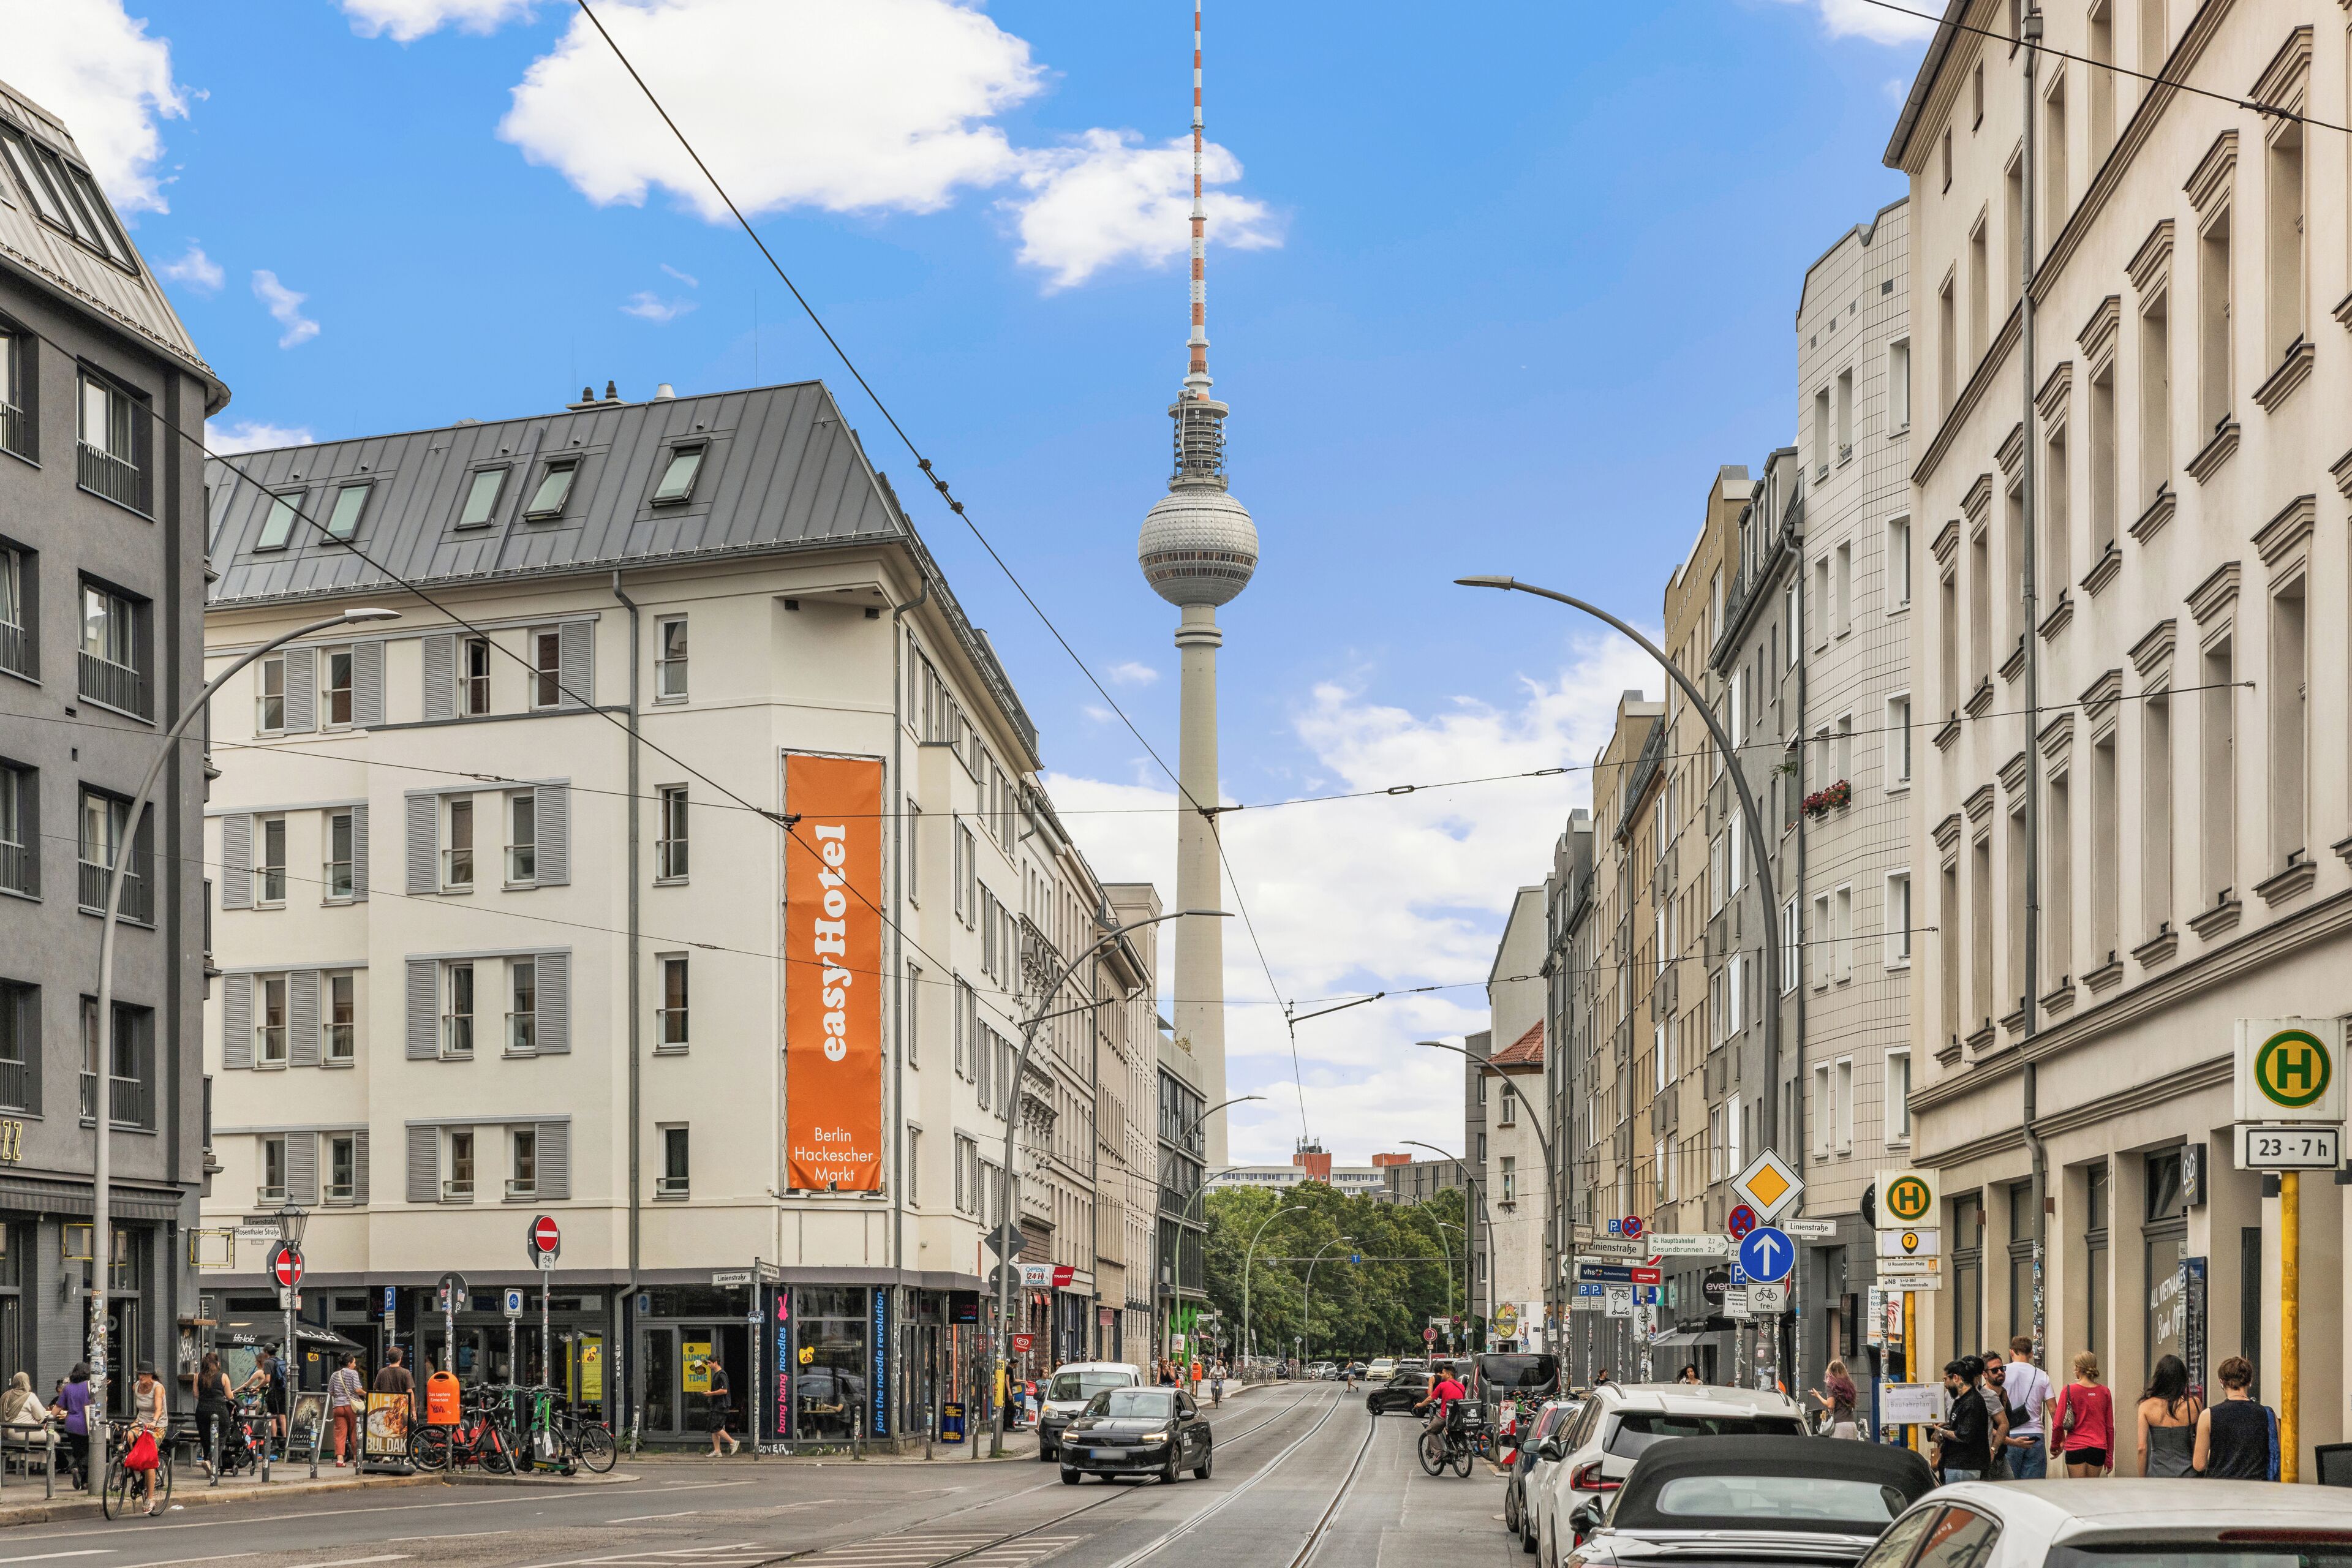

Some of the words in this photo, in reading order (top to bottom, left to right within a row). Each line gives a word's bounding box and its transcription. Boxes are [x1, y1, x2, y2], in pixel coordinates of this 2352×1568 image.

[815, 824, 852, 1061] easyHotel
[2277, 1049, 2312, 1089] H
[815, 1127, 851, 1142] Berlin
[795, 1146, 873, 1162] Hackescher
[2259, 1139, 2282, 1156] 23
[2301, 1139, 2312, 1156] 7
[2318, 1139, 2327, 1156] h
[815, 1166, 854, 1181] Markt
[1899, 1186, 1920, 1210] H
[265, 1228, 279, 1236] Straße
[1610, 1221, 1617, 1231] P
[1790, 1223, 1828, 1232] Linienstraße
[1589, 1242, 1637, 1254] Linienstraße
[1907, 1236, 1913, 1245] 7
[1734, 1266, 1743, 1282] P
[1580, 1286, 1587, 1295] P
[1593, 1286, 1599, 1295] P
[875, 1291, 884, 1348] revolution
[233, 1333, 257, 1343] fritz-kola
[778, 1327, 786, 1371] noodles
[778, 1374, 787, 1402] bang
[778, 1404, 787, 1433] bang
[876, 1412, 886, 1434] join
[366, 1437, 385, 1452] BUL
[386, 1438, 407, 1453] DAK
